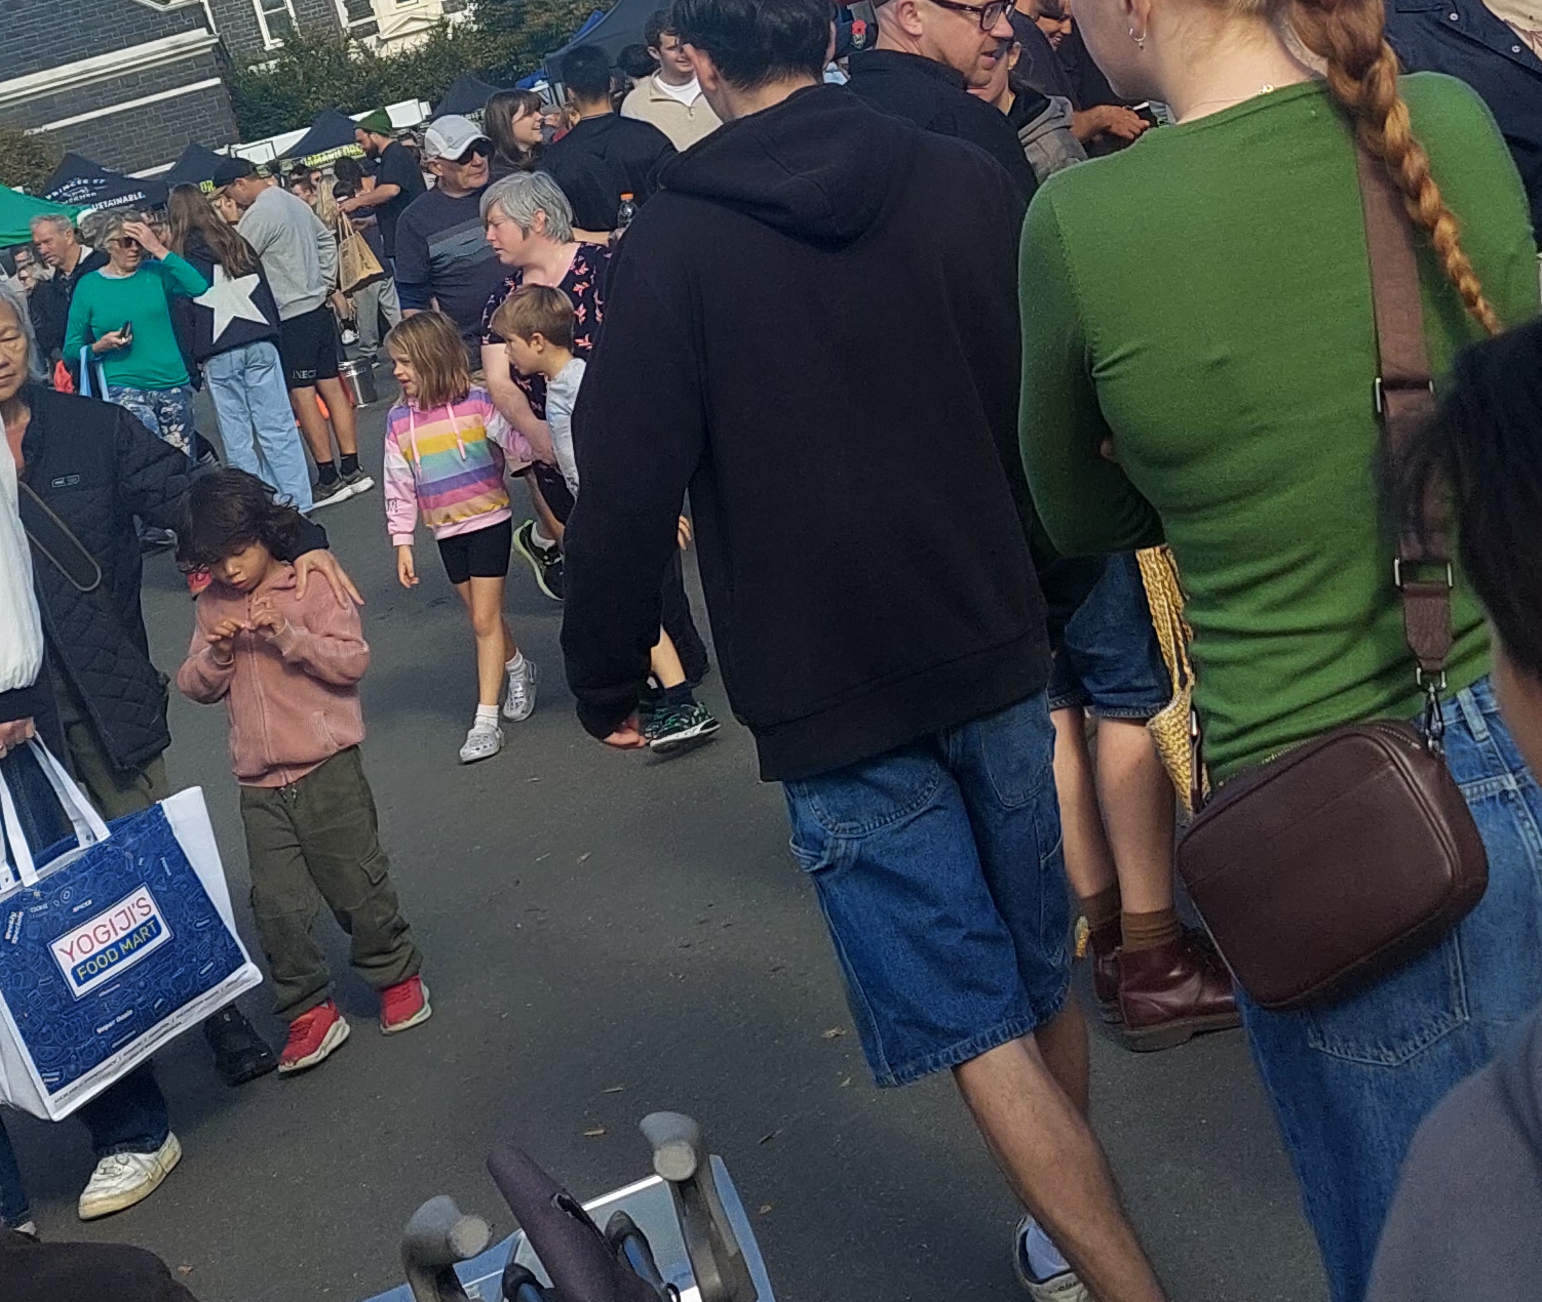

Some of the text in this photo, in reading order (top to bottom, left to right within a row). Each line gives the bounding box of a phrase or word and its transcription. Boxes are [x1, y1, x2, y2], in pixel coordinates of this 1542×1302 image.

[59, 896, 152, 963] YOGIJI'S
[76, 919, 158, 981] FOOD MART
